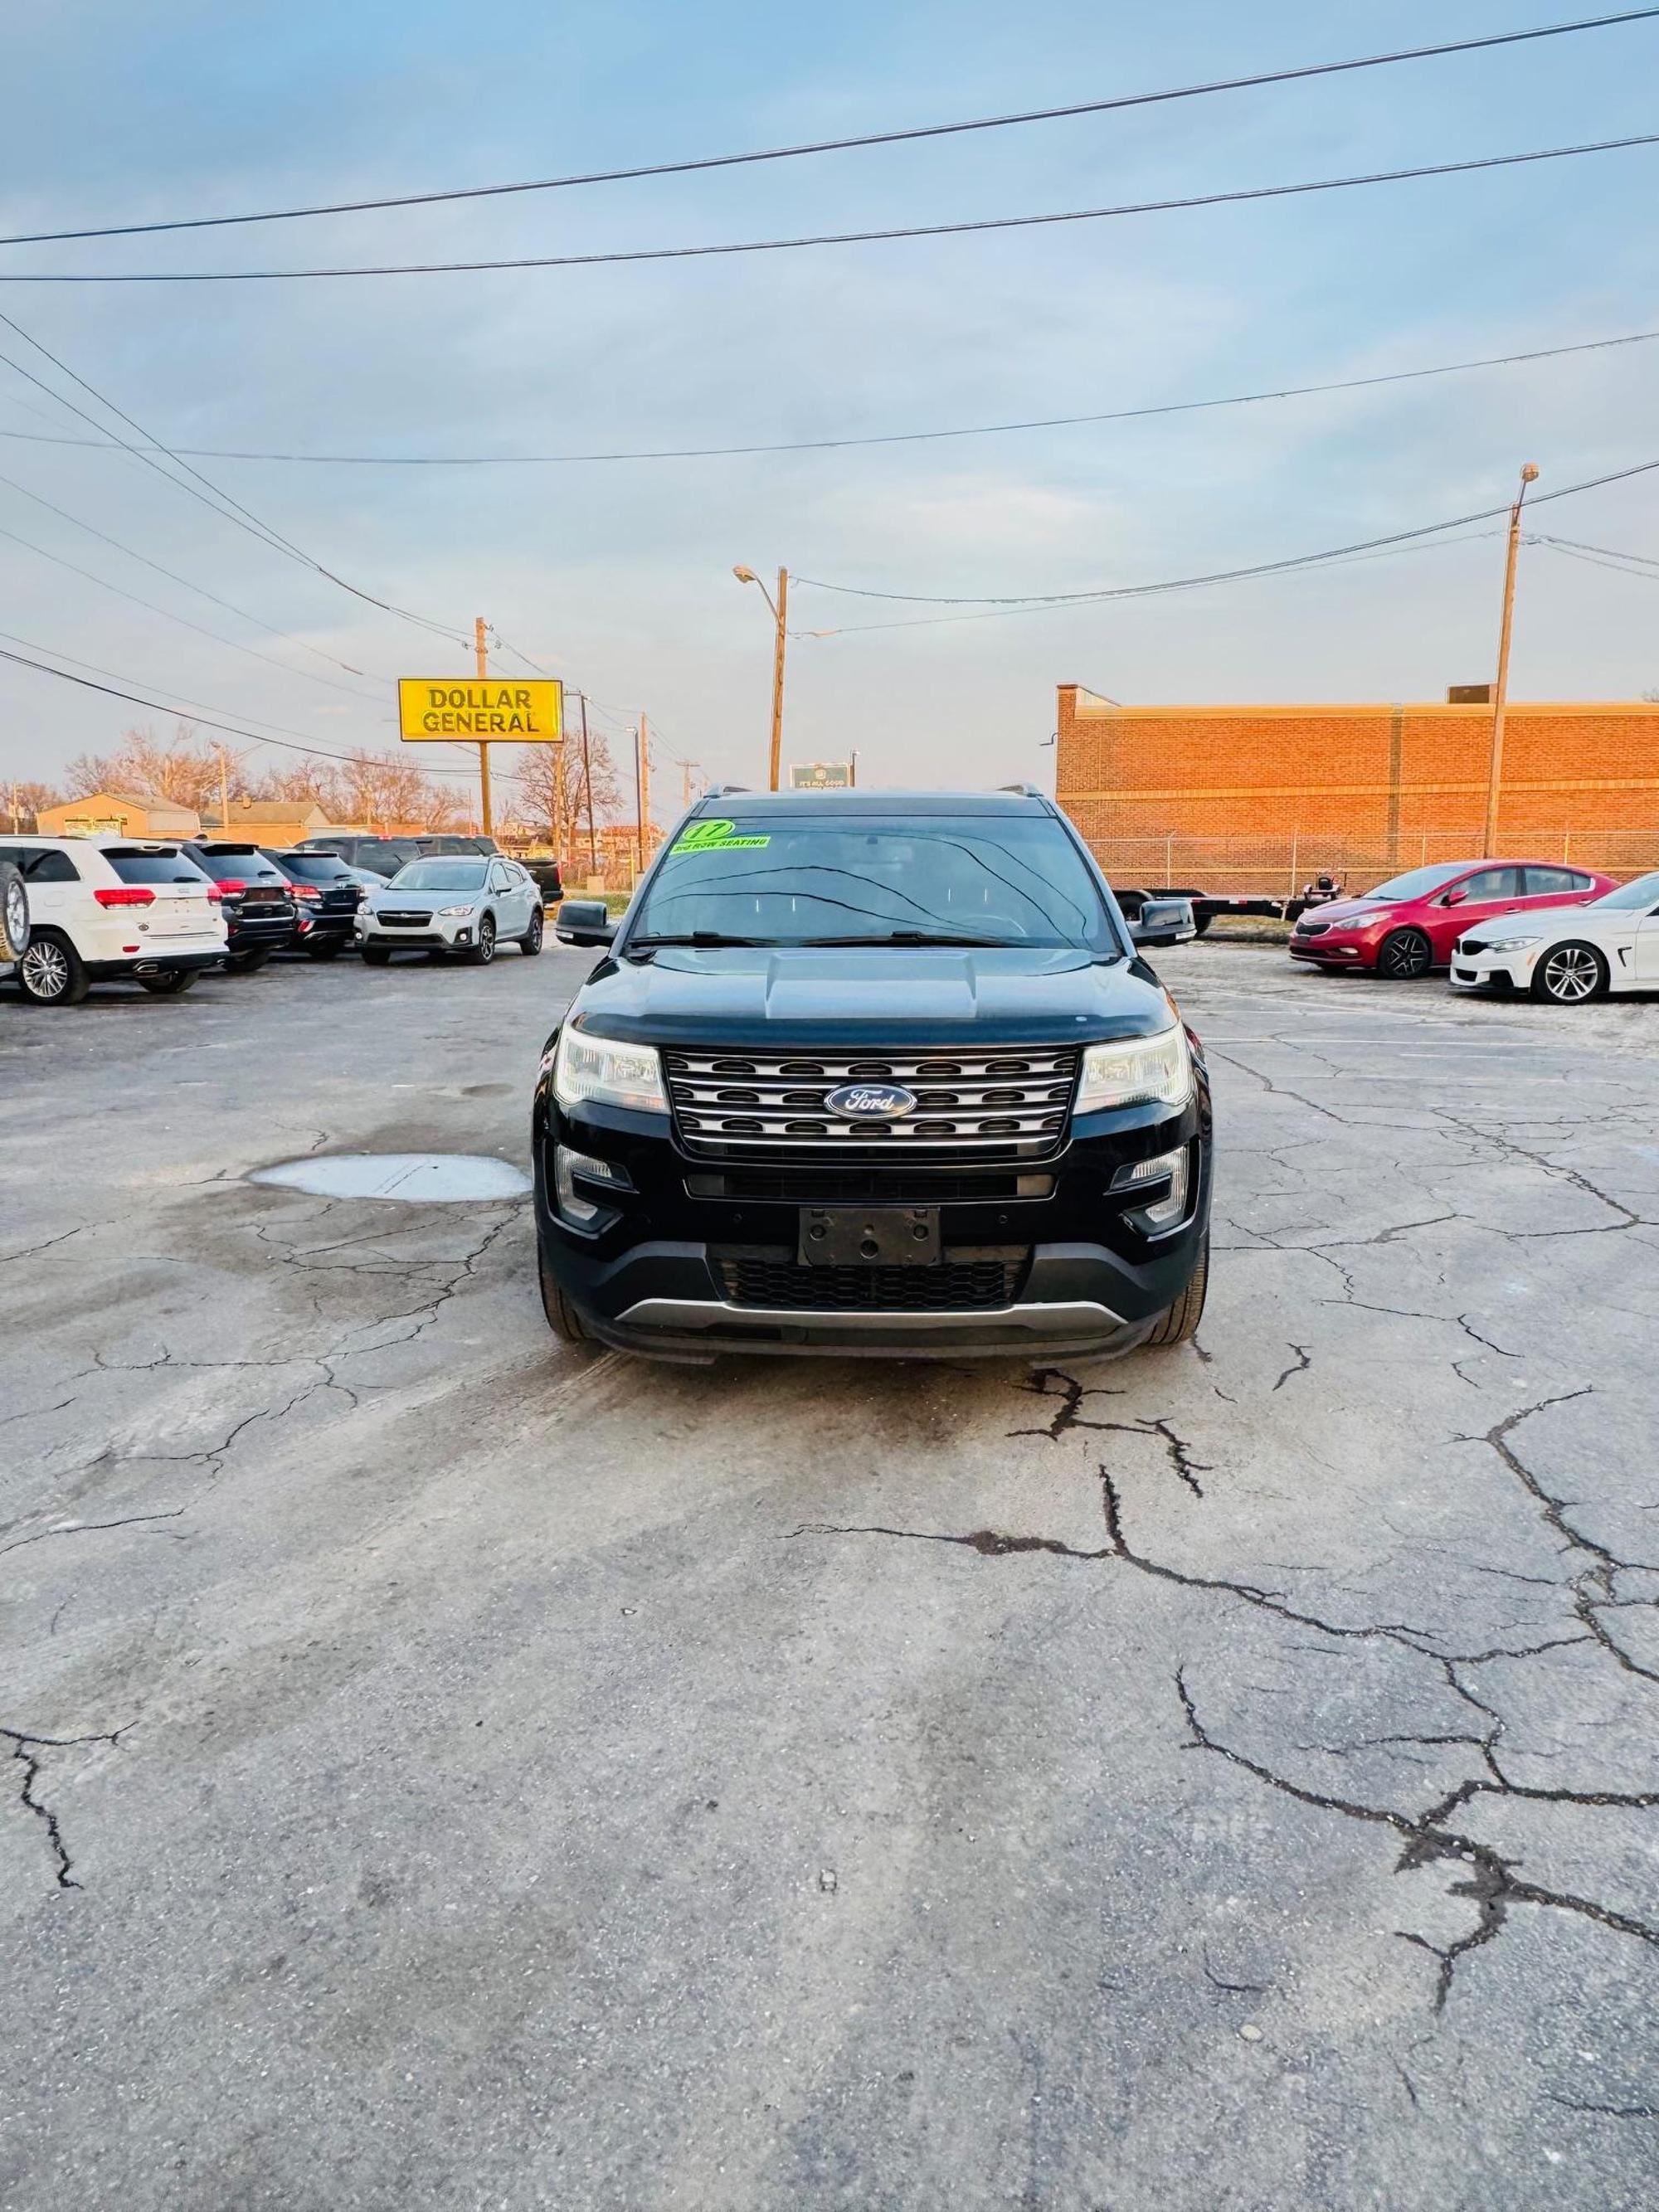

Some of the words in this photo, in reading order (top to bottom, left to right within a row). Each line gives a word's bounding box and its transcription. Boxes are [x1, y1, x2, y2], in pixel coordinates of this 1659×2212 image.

[429, 689, 533, 709] DOLLAR
[423, 712, 541, 732] GENERAL
[689, 822, 727, 839] 17
[692, 841, 718, 850] ROW
[719, 838, 767, 847] SEATING
[845, 1088, 896, 1111] Ford
